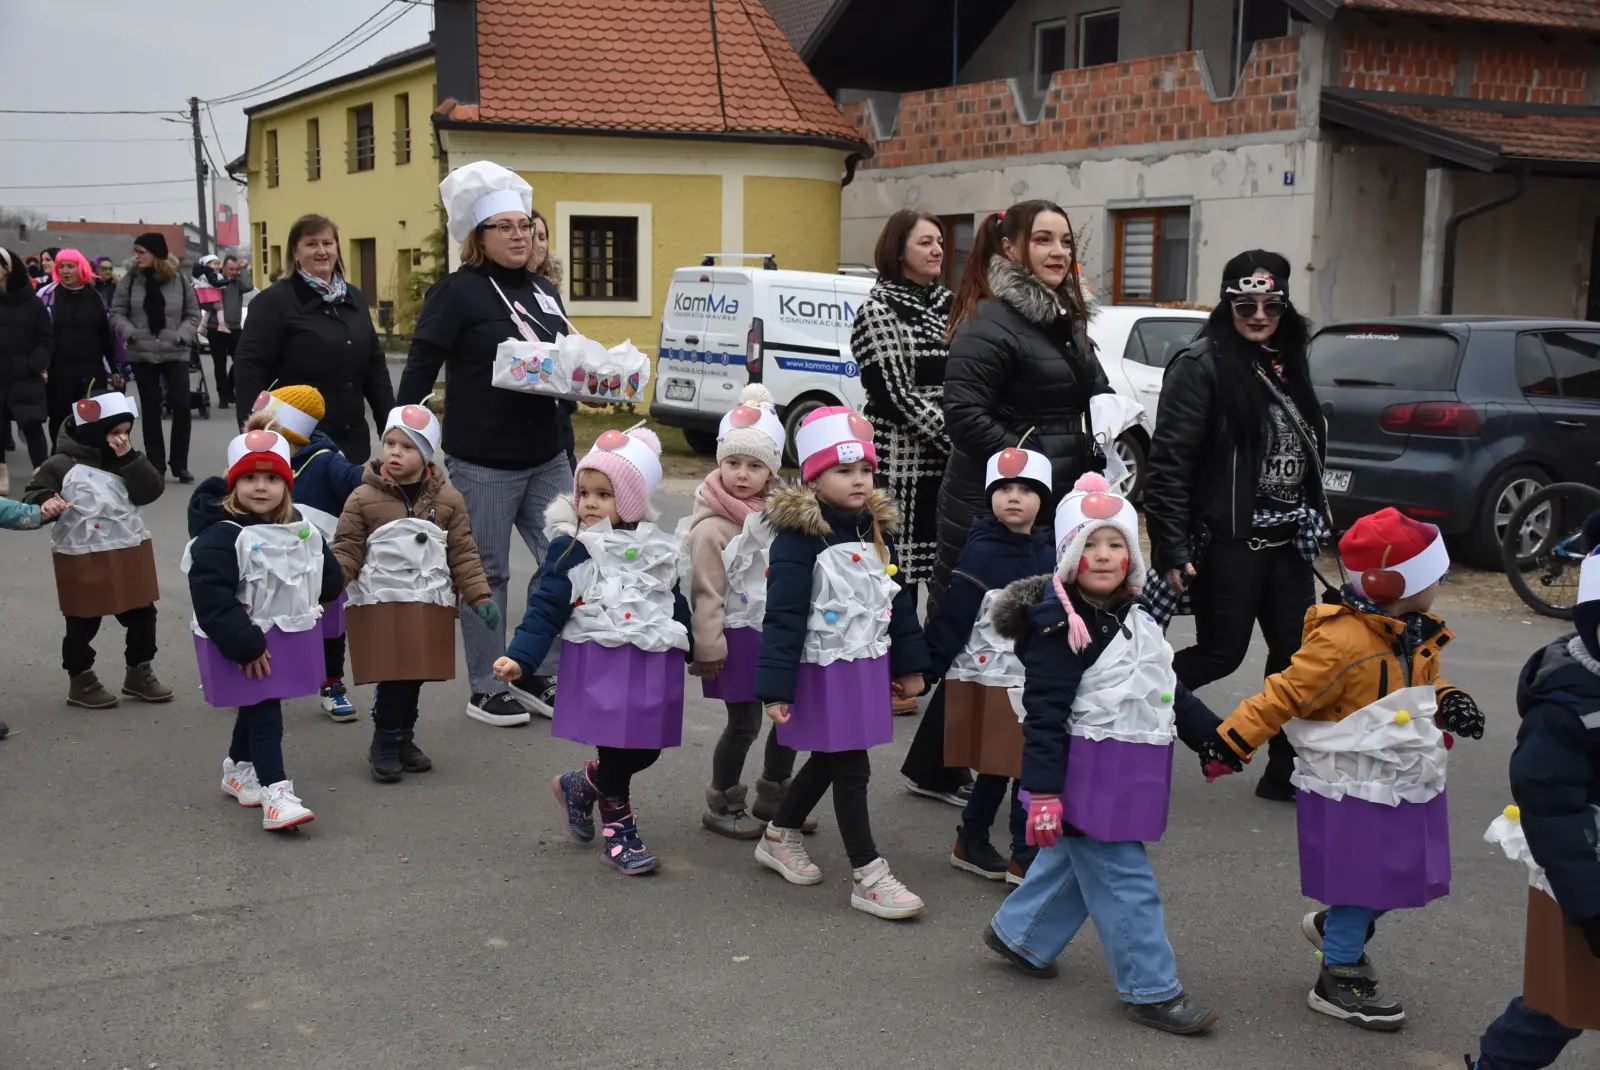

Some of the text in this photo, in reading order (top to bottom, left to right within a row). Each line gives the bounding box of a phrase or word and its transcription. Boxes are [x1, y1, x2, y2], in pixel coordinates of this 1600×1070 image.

[674, 292, 739, 315] KomMa
[779, 294, 856, 321] Kom
[706, 313, 738, 321] MAVREK
[780, 316, 842, 328] KOMUNIKACIJE
[785, 360, 839, 372] www.komma.hr
